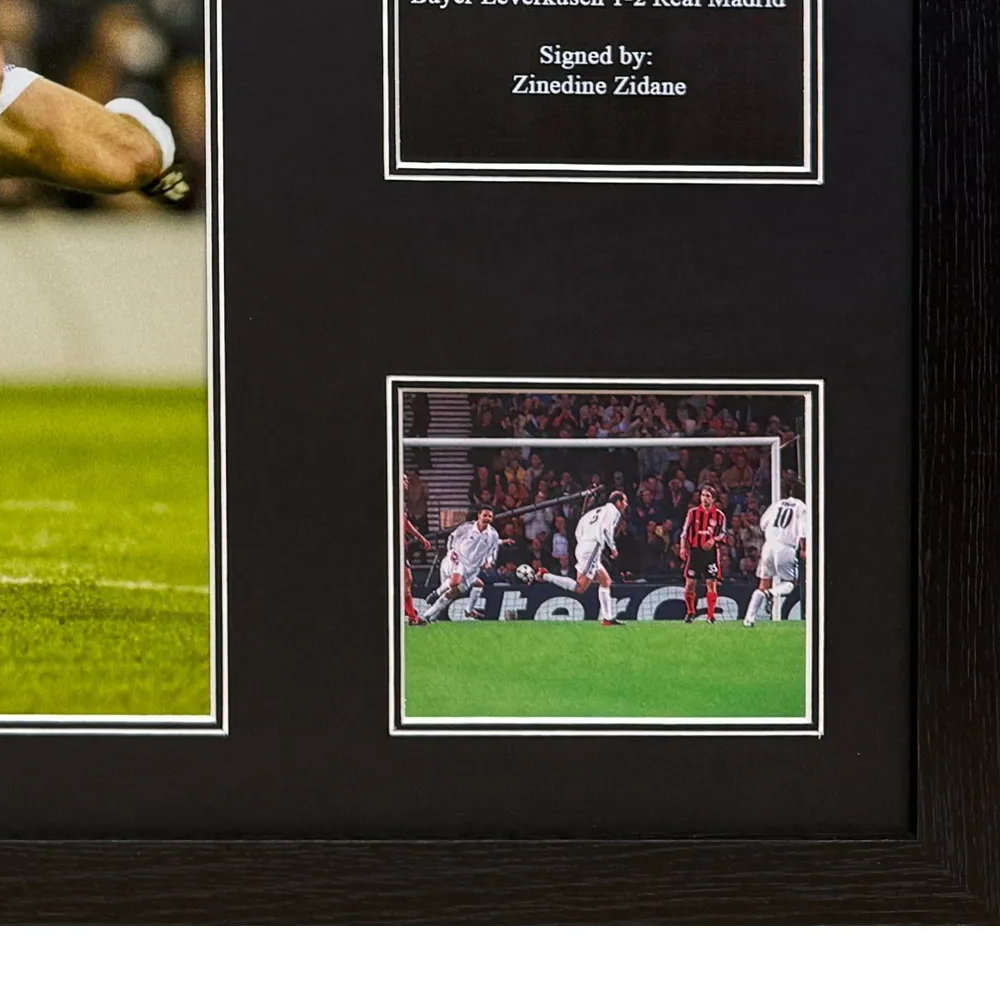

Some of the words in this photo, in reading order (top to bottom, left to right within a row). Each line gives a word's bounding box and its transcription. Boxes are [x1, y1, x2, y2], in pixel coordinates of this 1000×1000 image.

[539, 44, 614, 70] Signed
[618, 45, 653, 71] by:
[511, 74, 607, 95] Zinedine
[613, 75, 687, 96] Zidane
[773, 506, 794, 529] 10
